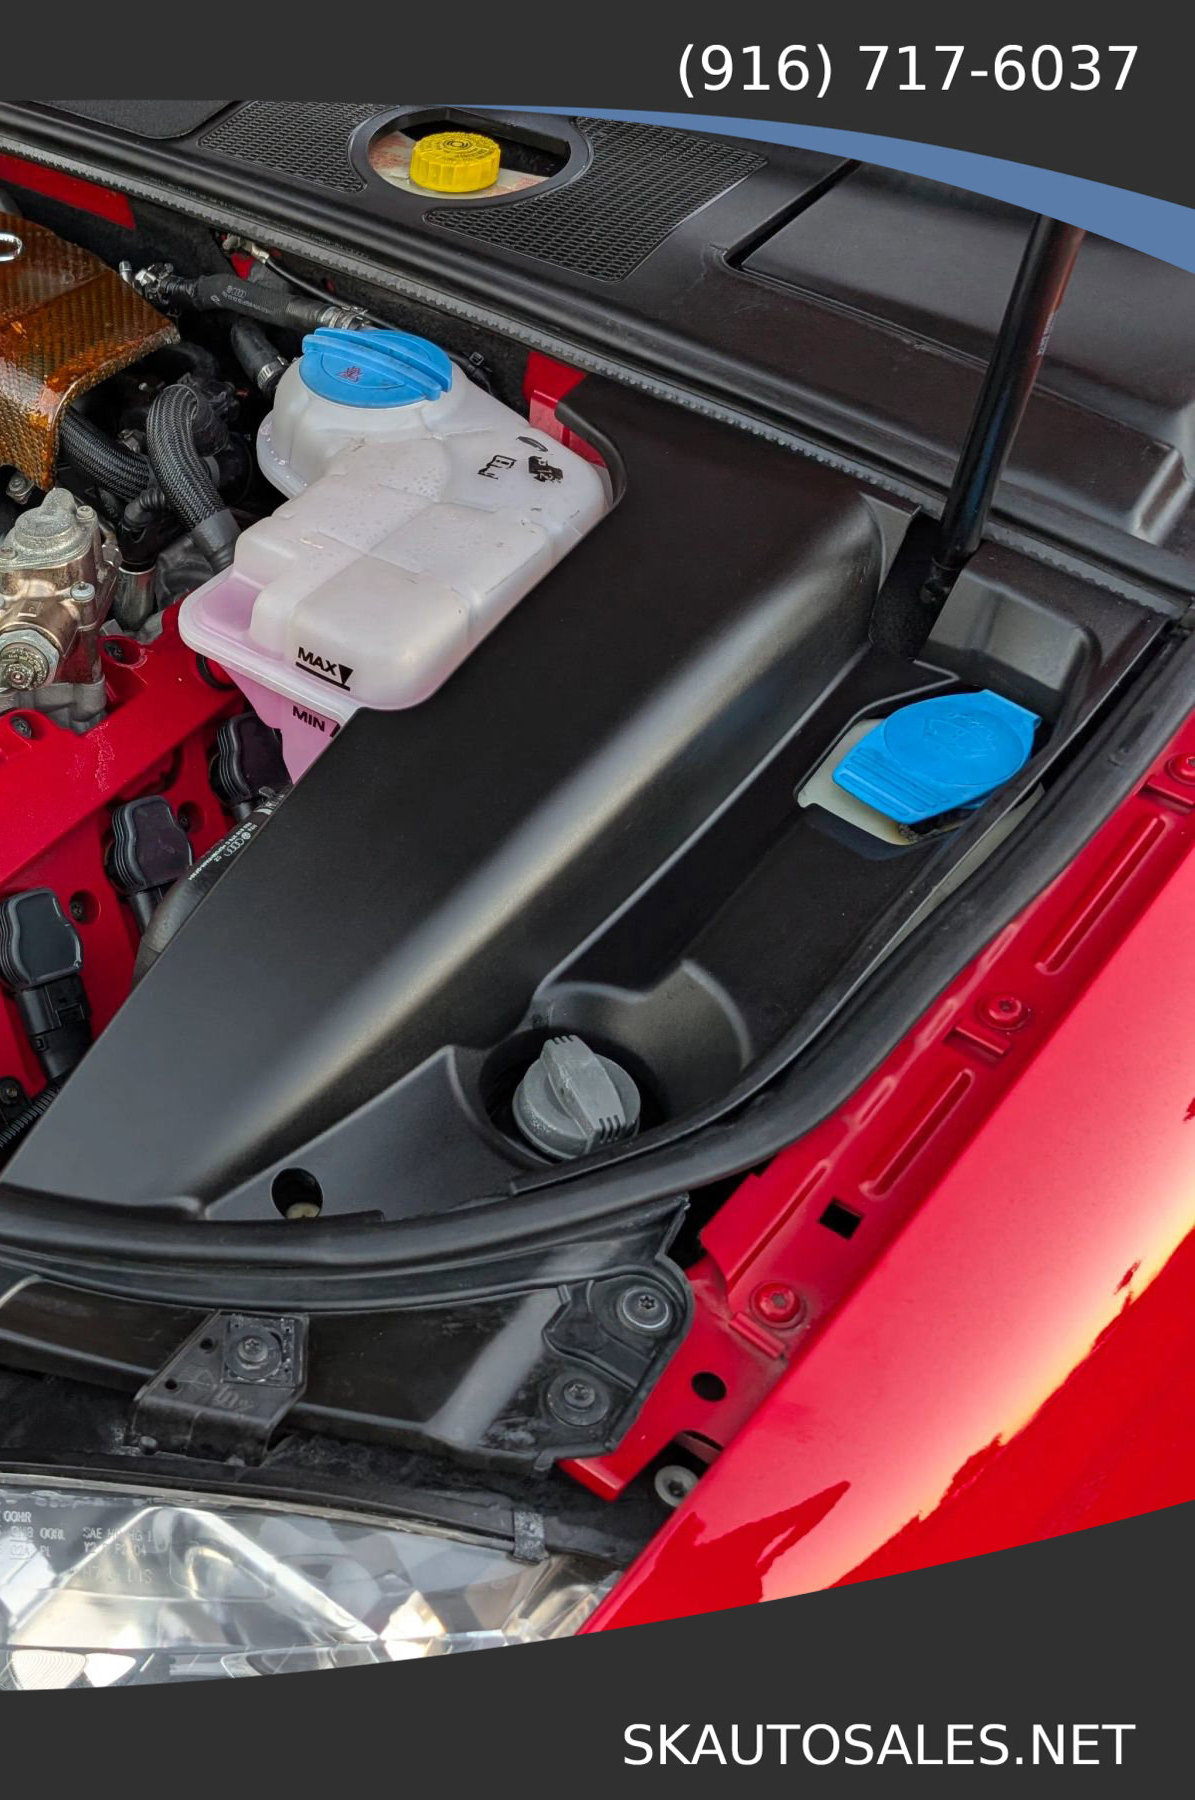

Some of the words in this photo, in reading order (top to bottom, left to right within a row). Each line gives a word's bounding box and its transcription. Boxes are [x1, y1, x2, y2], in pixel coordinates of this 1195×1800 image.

[298, 646, 337, 676] MAX
[292, 705, 325, 732] MIN
[82, 1526, 103, 1540] SAE
